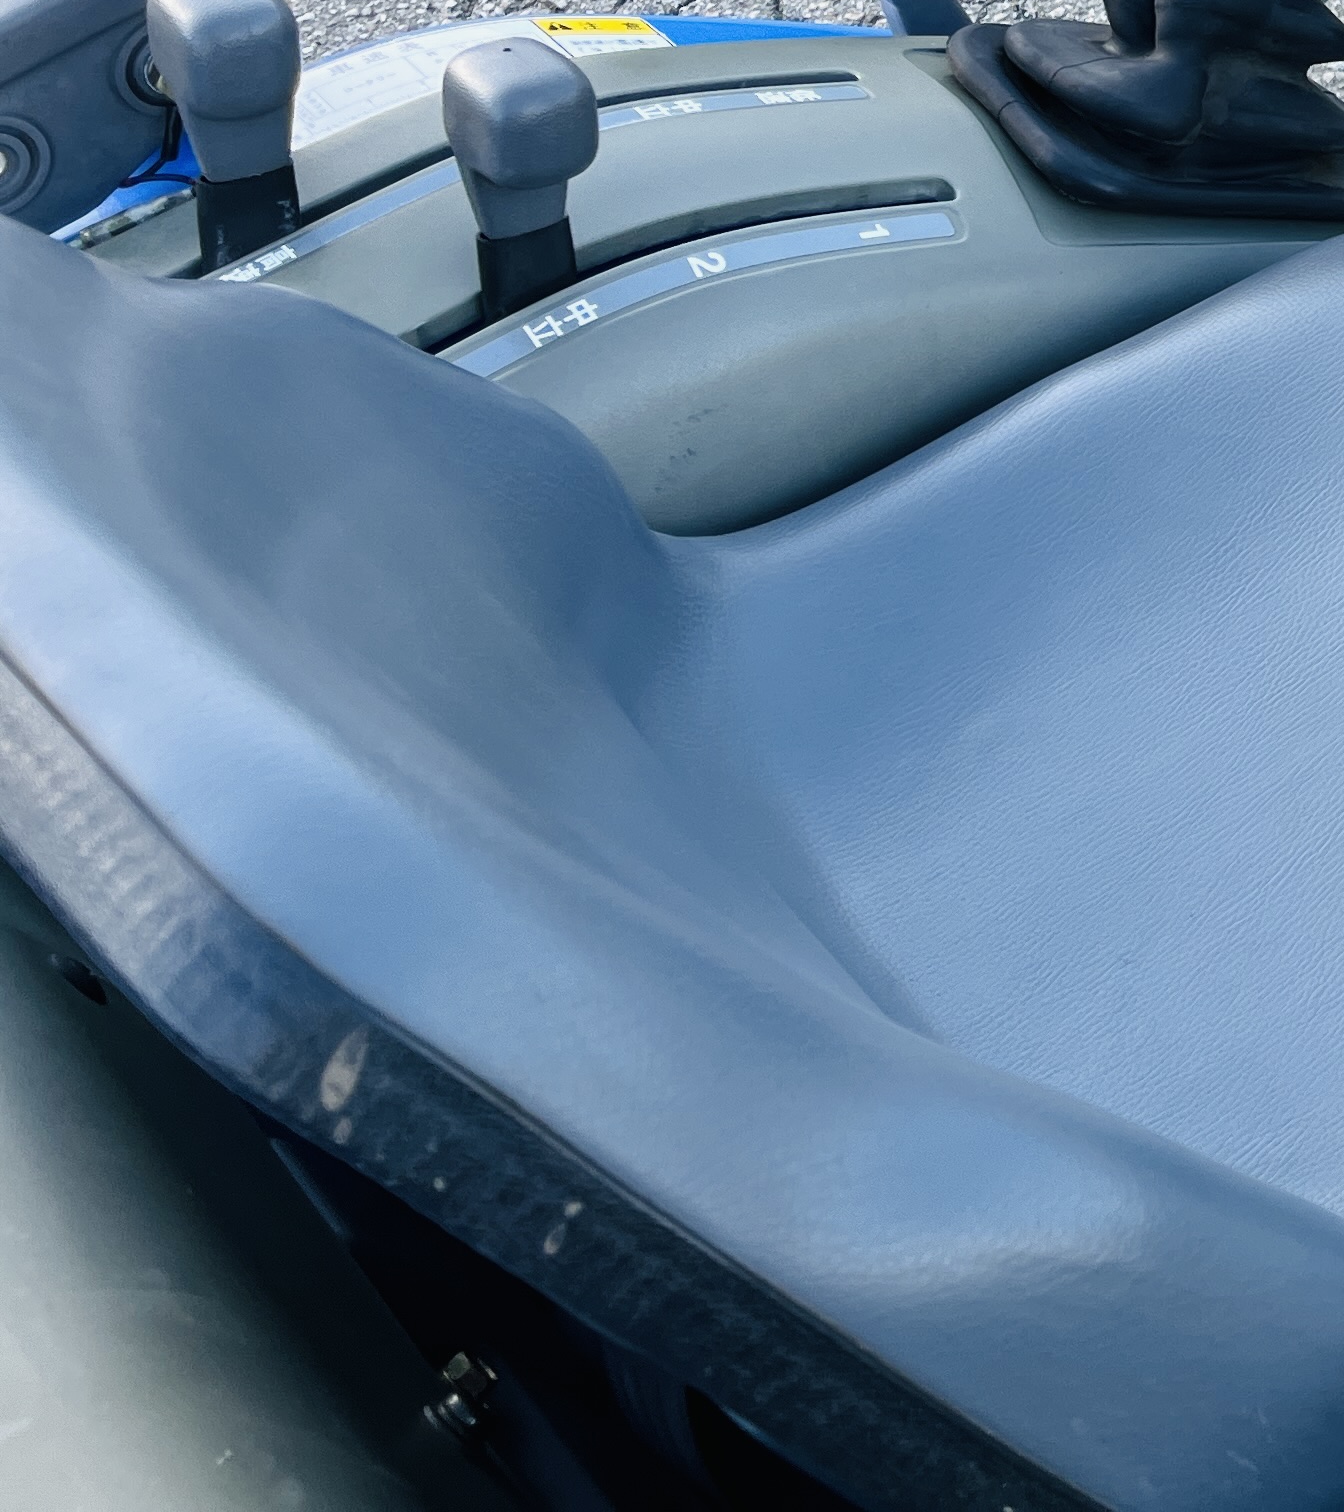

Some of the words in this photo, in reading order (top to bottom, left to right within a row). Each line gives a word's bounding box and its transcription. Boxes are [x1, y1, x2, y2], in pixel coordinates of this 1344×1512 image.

[633, 98, 702, 121] 中立
[858, 223, 891, 240] 1
[686, 252, 727, 278] 2
[522, 298, 599, 349] 中立
